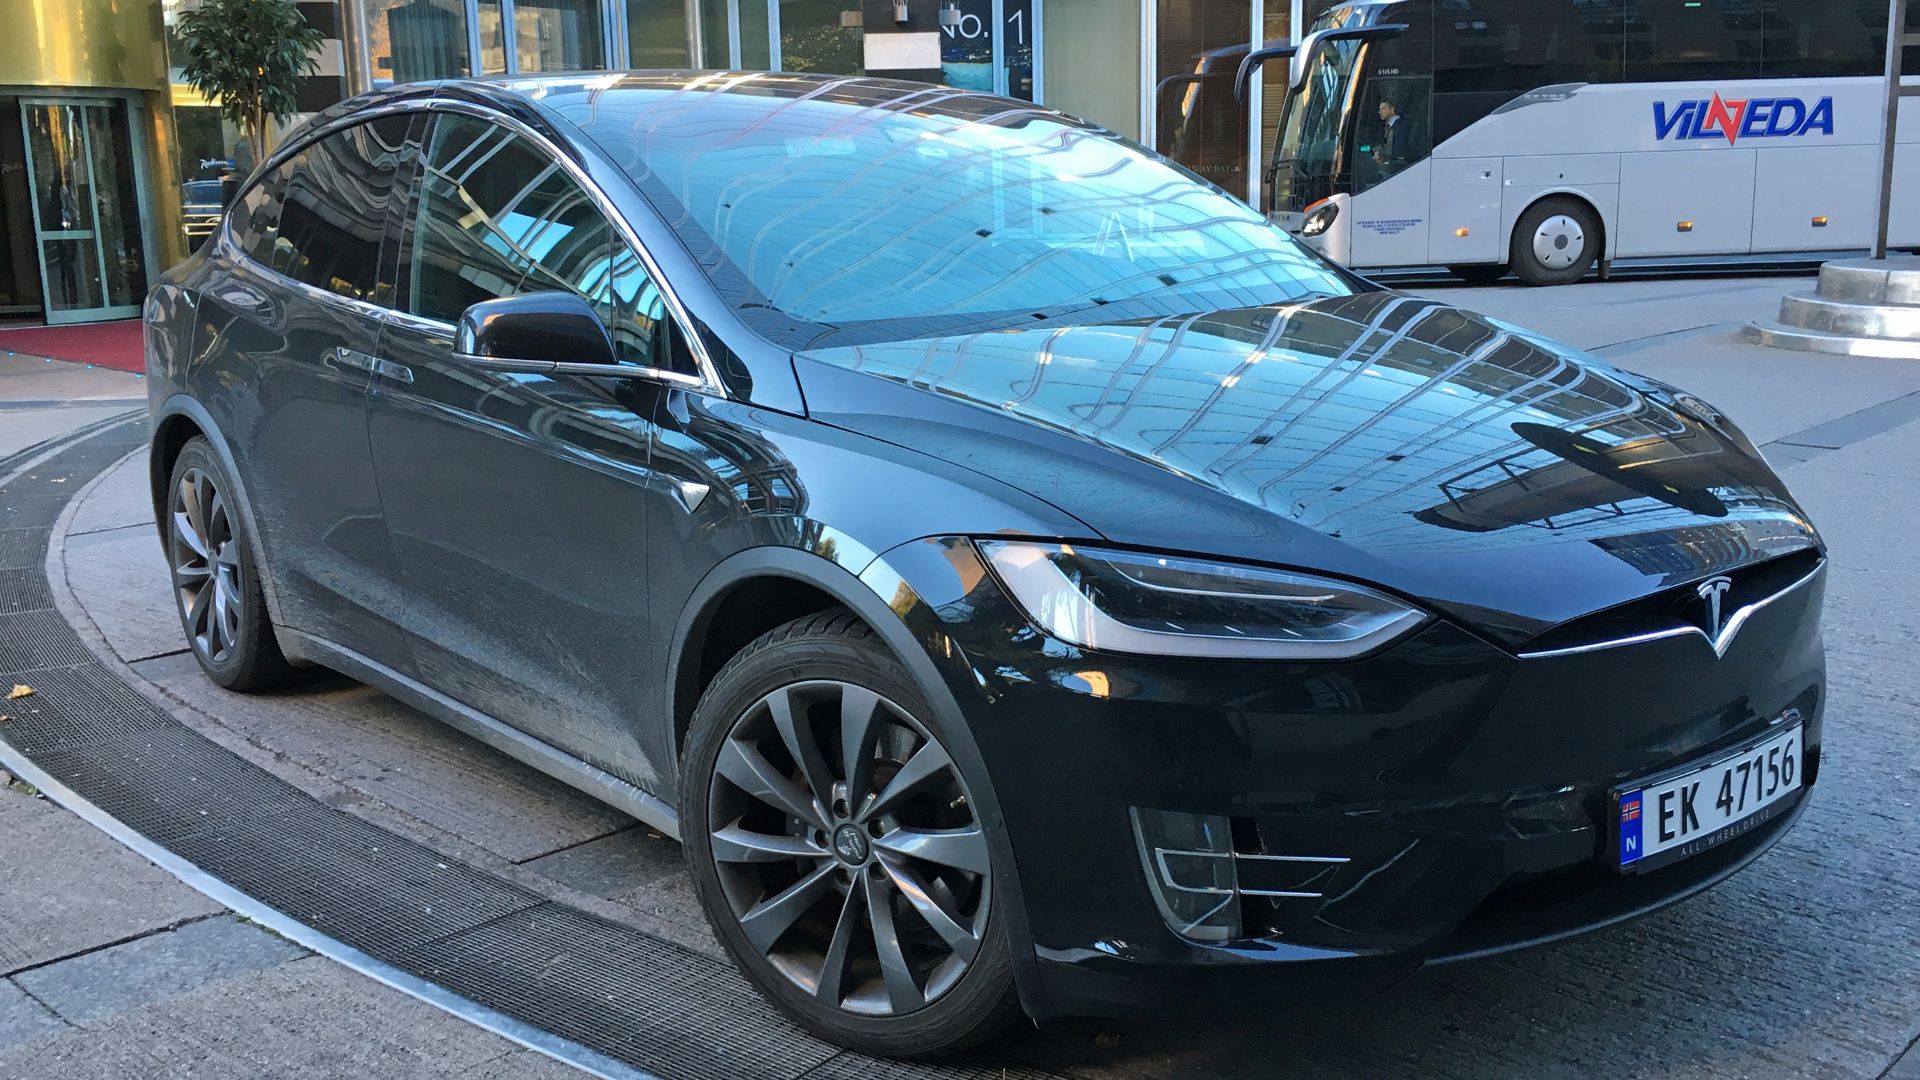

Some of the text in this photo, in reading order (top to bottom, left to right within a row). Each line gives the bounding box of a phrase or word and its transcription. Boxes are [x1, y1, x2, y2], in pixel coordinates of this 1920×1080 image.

[1007, 9, 1023, 44] 1
[1658, 736, 1795, 844] EK 47156
[1743, 808, 1771, 830] DRIVE
[1625, 834, 1637, 853] N
